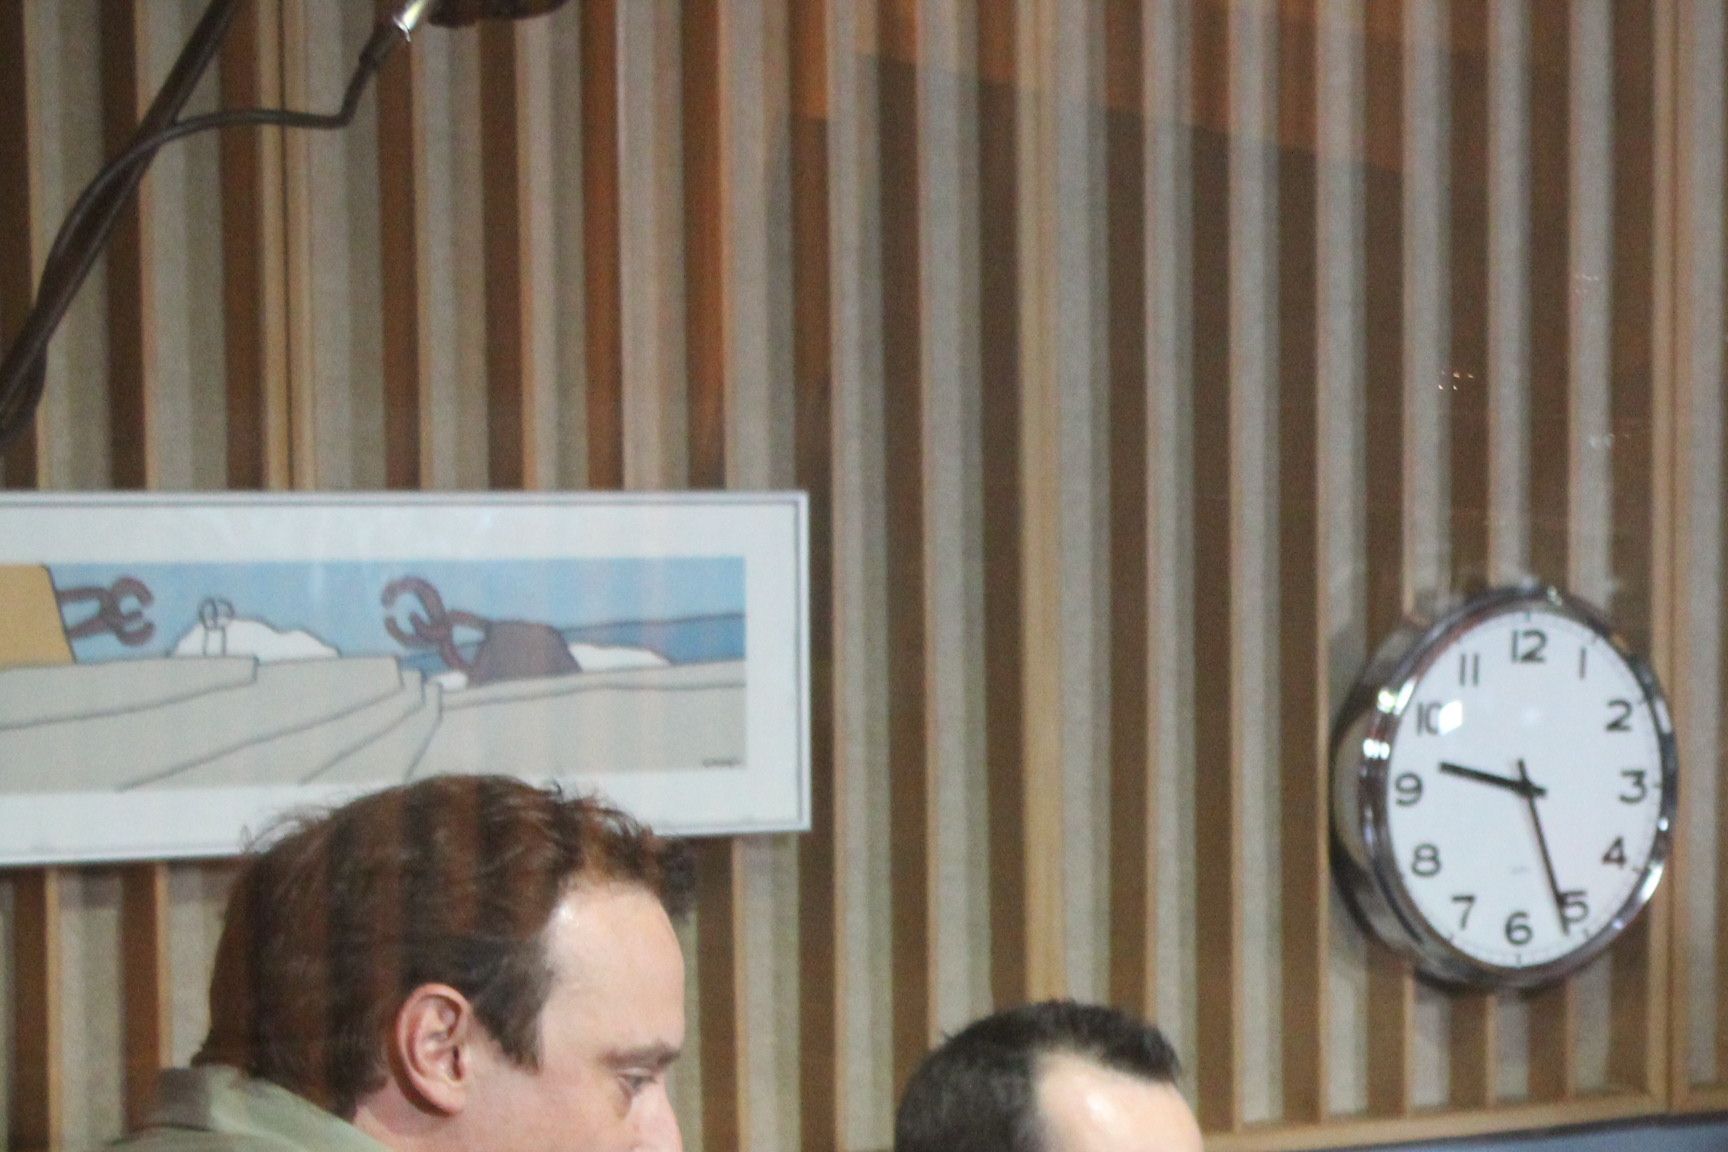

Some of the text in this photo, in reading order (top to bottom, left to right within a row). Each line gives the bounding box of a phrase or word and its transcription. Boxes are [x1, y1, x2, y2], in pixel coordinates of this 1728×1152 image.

[1511, 630, 1548, 664] 12
[1579, 646, 1588, 681] 1
[1459, 653, 1480, 686] 11
[1606, 700, 1634, 733] 2
[1395, 773, 1424, 807] 9
[1619, 770, 1649, 804] 3
[1412, 844, 1442, 877] 8
[1602, 837, 1627, 867] 4
[1452, 895, 1477, 930] 7
[1559, 890, 1590, 923] 5
[1505, 912, 1534, 946] 6
